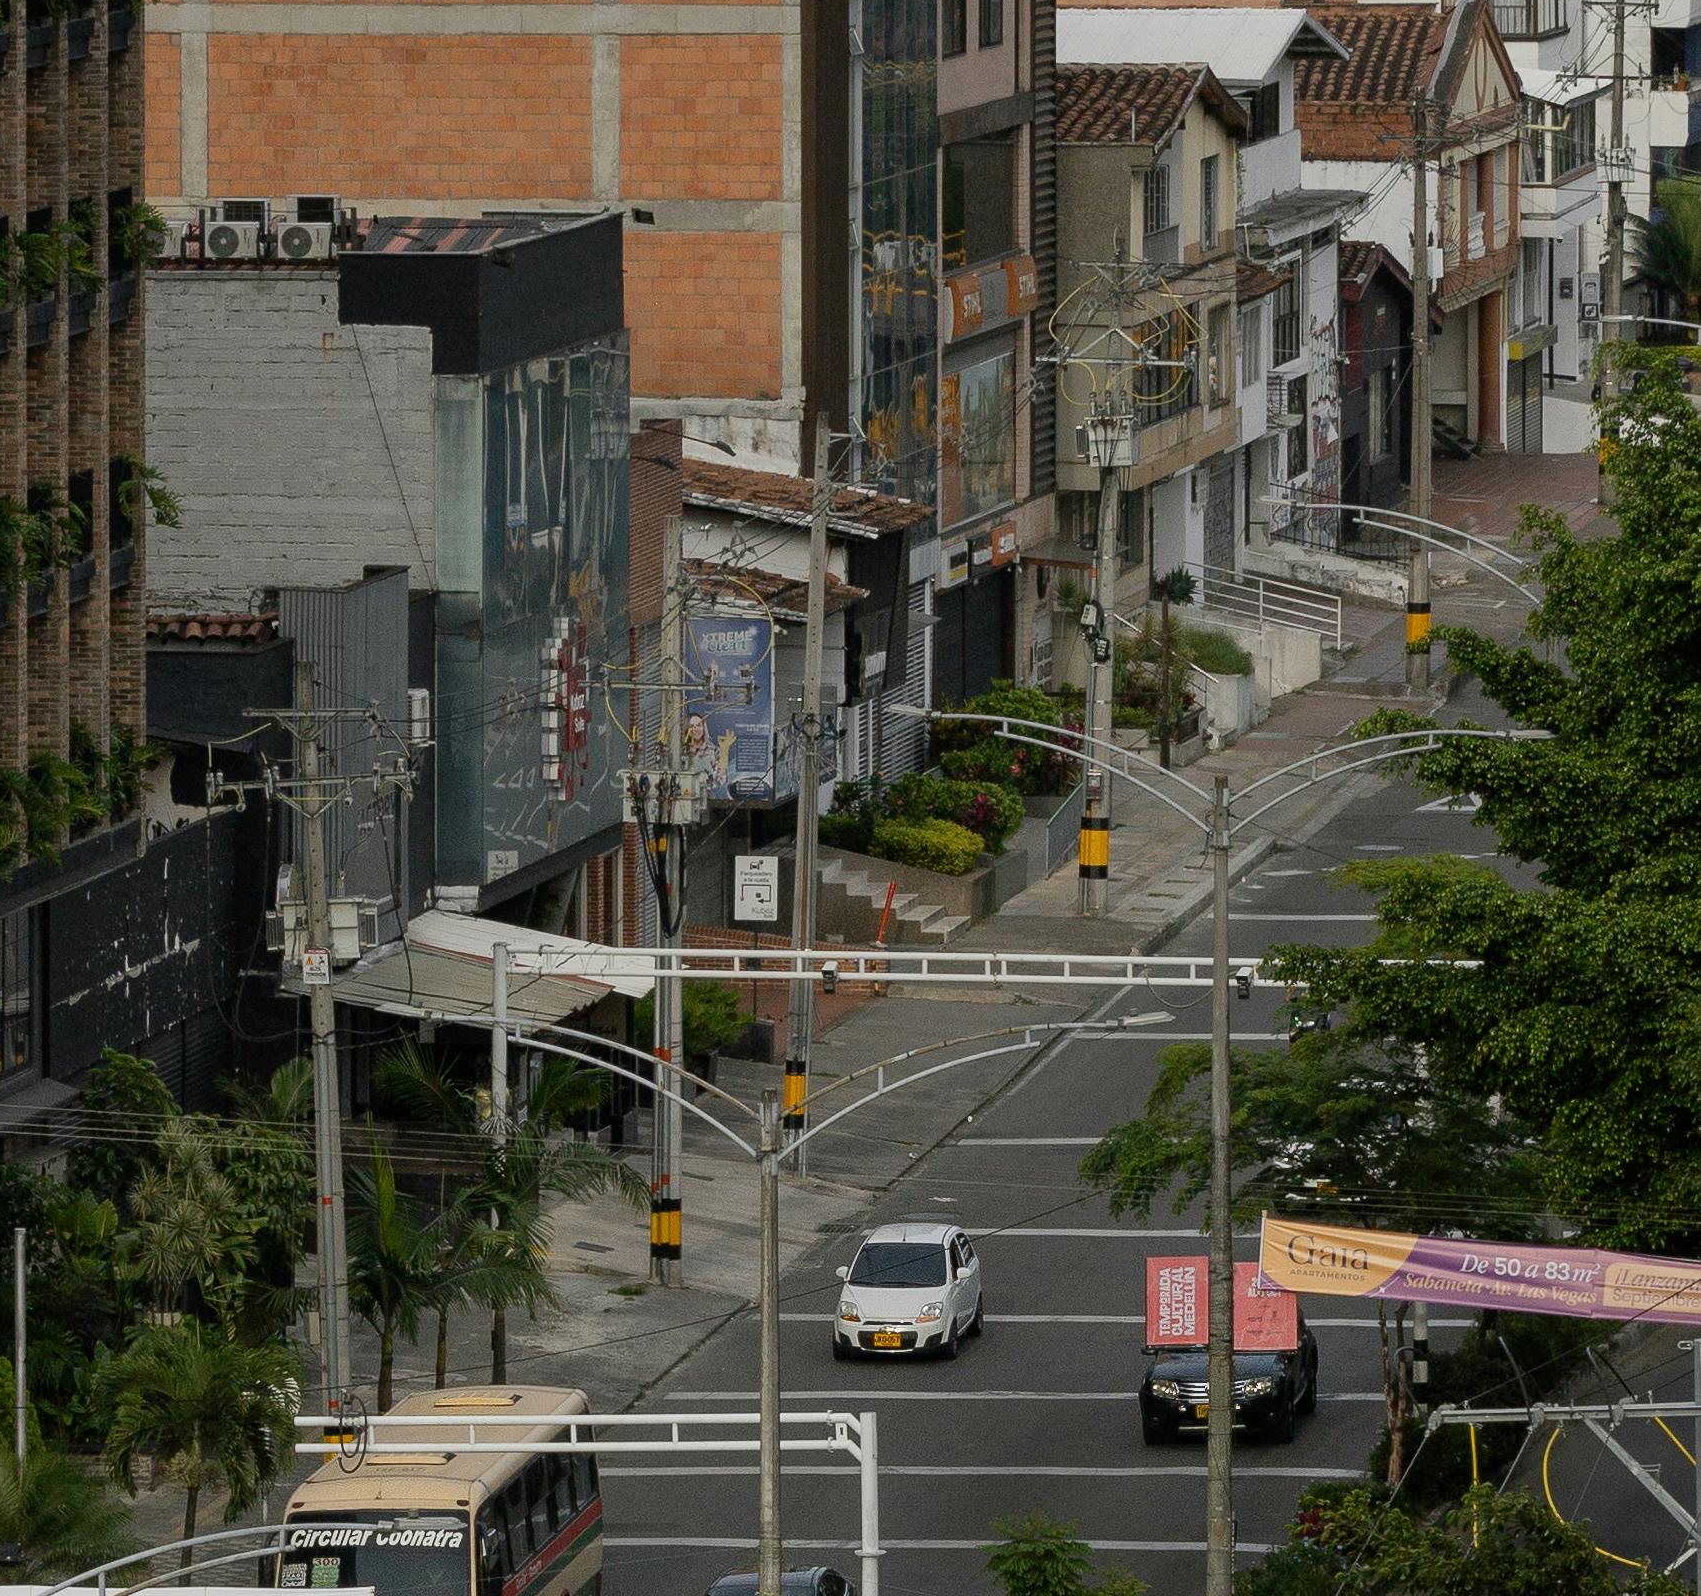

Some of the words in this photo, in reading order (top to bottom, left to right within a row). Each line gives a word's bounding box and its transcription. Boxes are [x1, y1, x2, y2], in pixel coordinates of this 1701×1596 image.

[702, 630, 753, 643] XTREME
[1287, 1235, 1370, 1271] Gaia
[1289, 1266, 1366, 1282] APARTAMENTOS
[1459, 1254, 1489, 1275] De
[1494, 1256, 1522, 1276] 50
[1525, 1265, 1539, 1278] a
[1545, 1261, 1571, 1281] 83
[1403, 1272, 1483, 1295] Sabaneta
[1518, 1283, 1546, 1300] Las
[1547, 1285, 1598, 1306] Vegas
[1612, 1288, 1700, 1307] Septiembre
[1159, 1267, 1171, 1336] TEMPORADA
[1171, 1266, 1183, 1336] CULTURAL
[291, 1529, 373, 1547] Circular
[314, 1558, 340, 1566] 300
